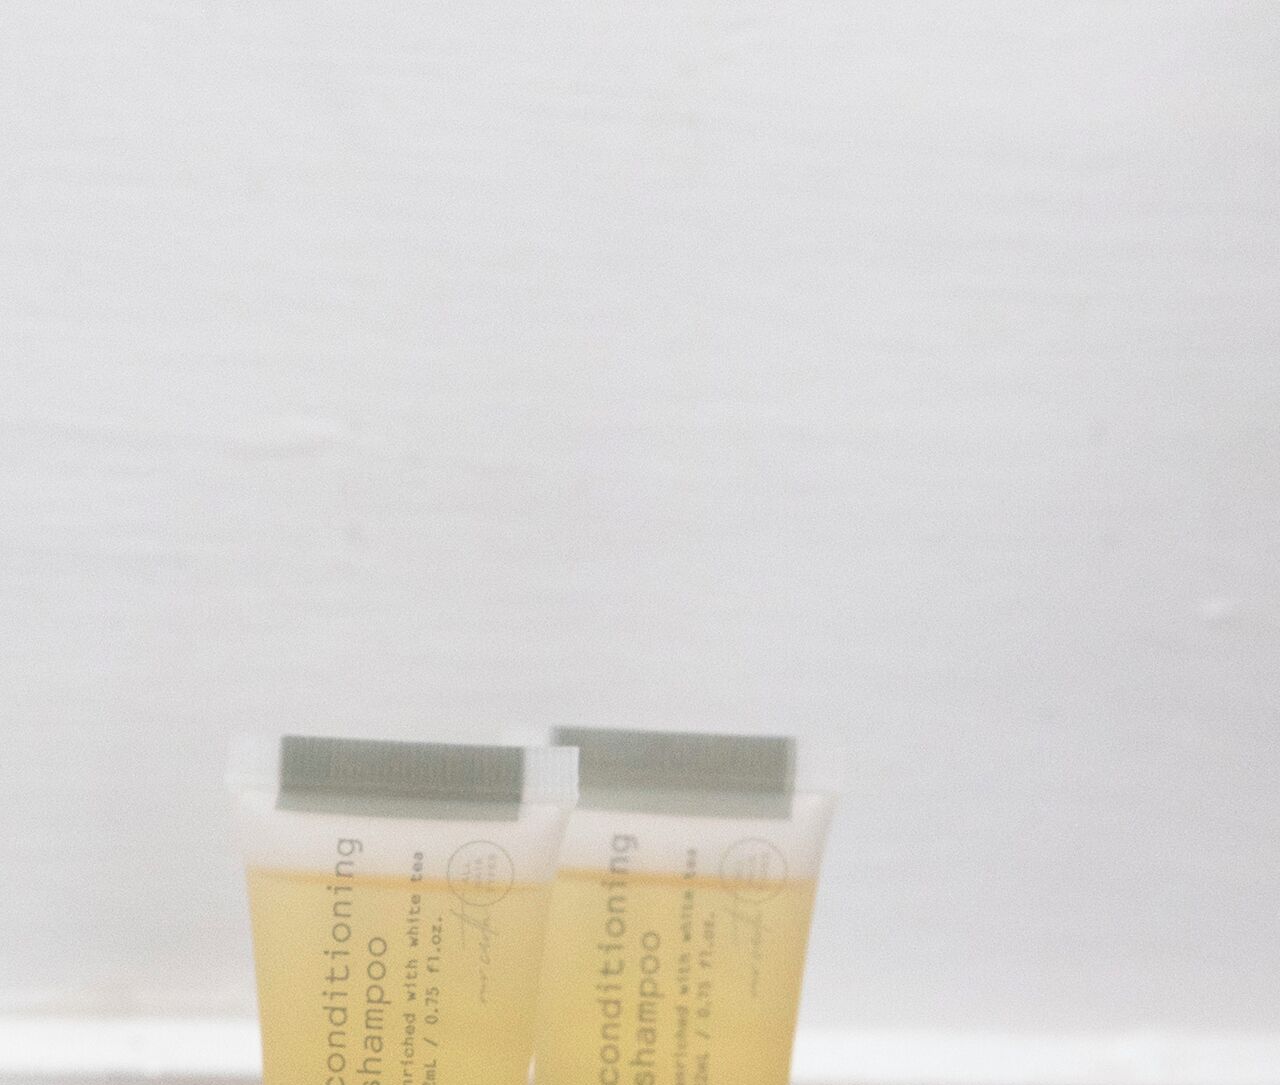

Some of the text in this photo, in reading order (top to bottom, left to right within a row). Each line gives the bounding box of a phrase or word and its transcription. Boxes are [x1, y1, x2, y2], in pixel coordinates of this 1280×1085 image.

[410, 851, 424, 883] tea
[407, 893, 422, 947] white
[405, 959, 419, 1001] with
[425, 986, 439, 1025] 0.75
